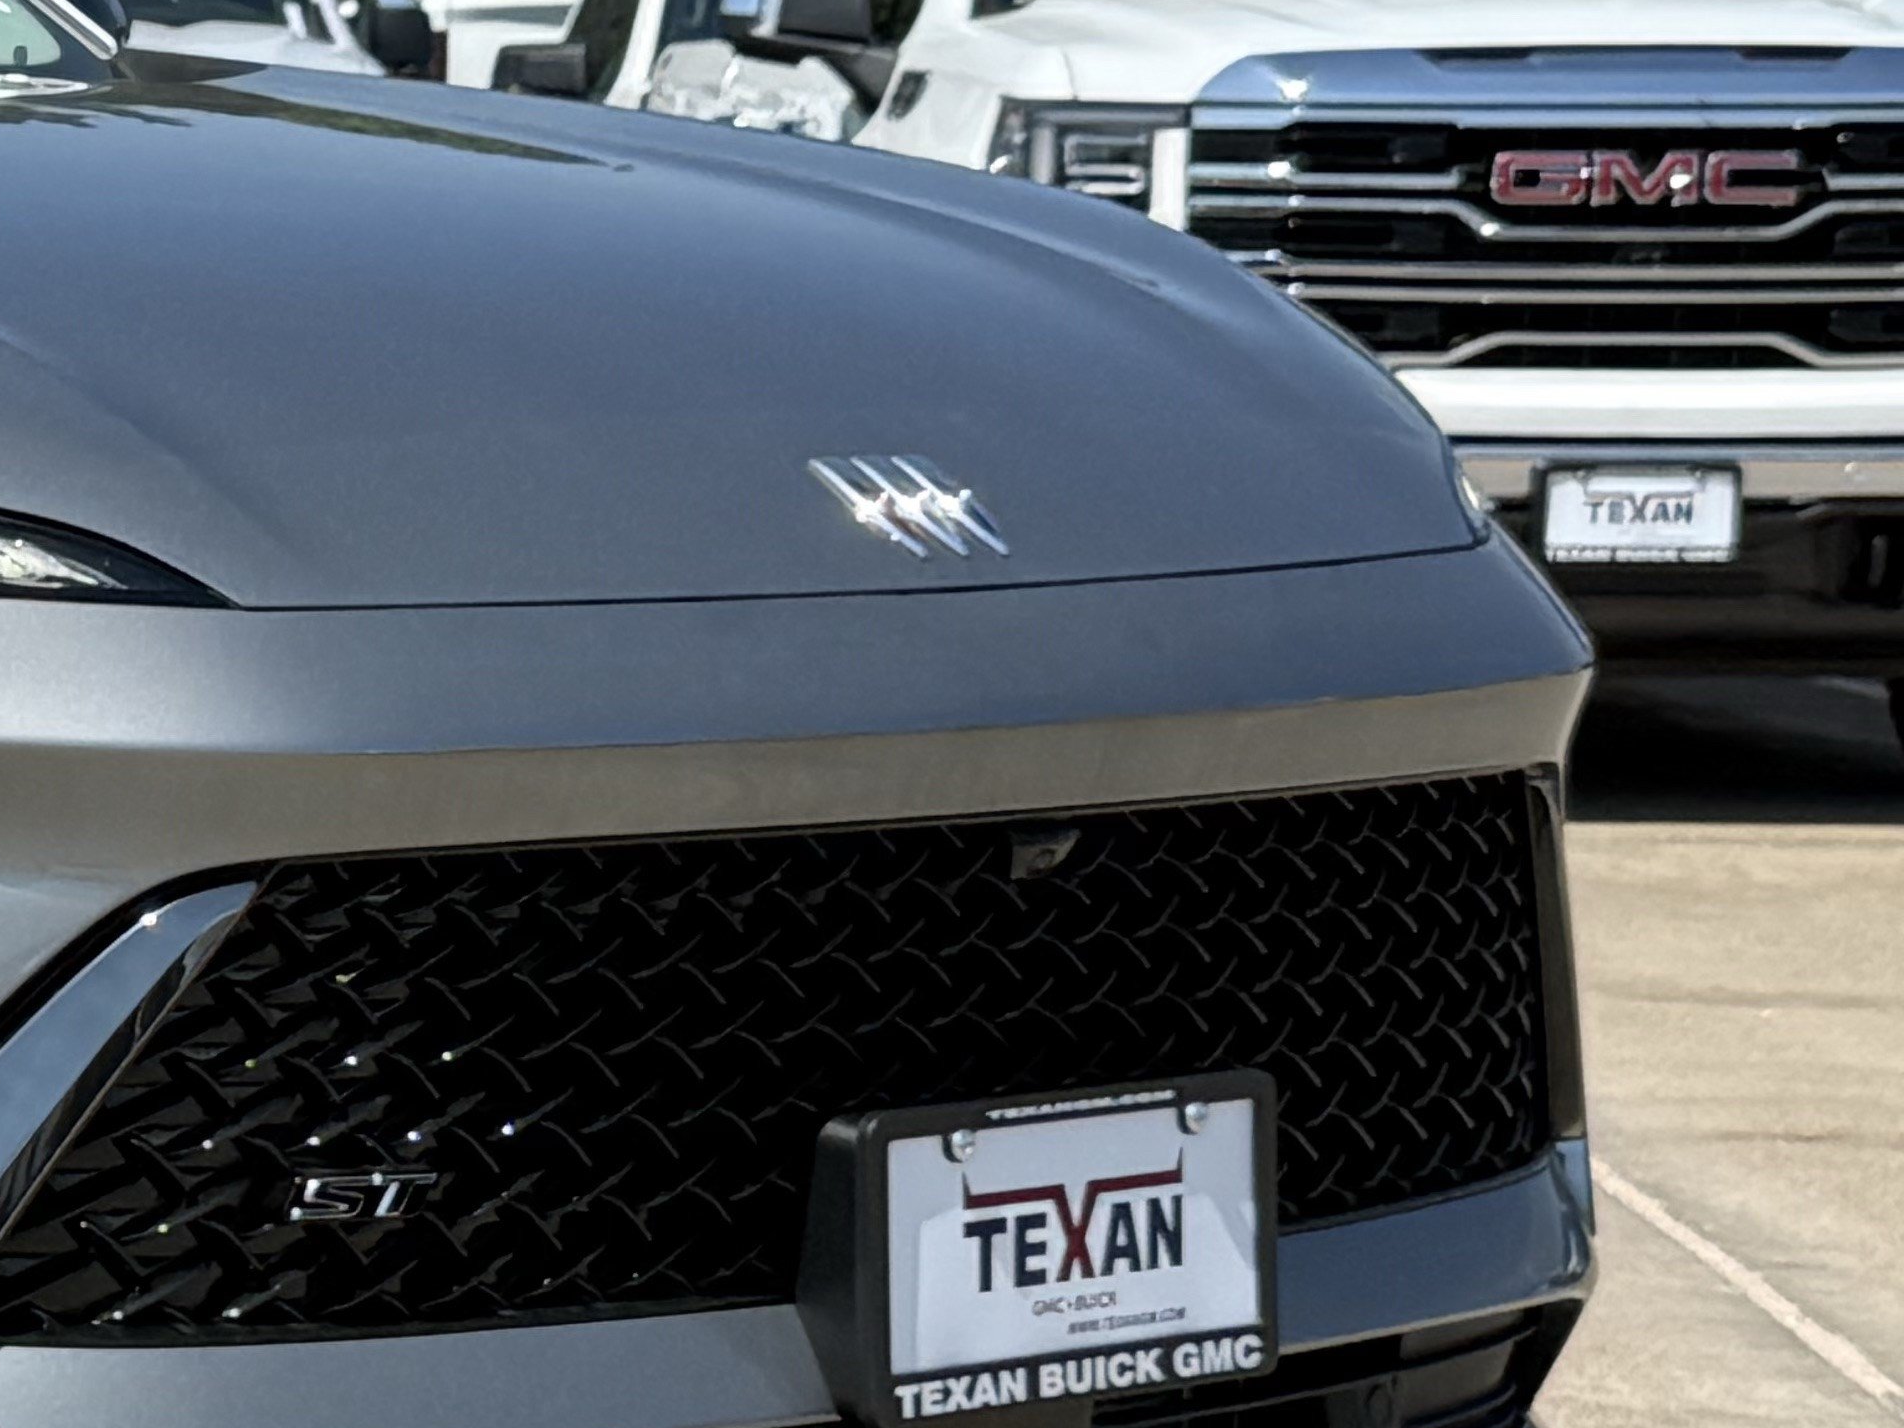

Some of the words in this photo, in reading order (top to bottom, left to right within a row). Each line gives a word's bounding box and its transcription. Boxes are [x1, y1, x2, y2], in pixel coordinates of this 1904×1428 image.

[1490, 149, 1798, 207] GMC
[1583, 492, 1695, 525] TEXAN
[288, 1172, 438, 1222] ST
[962, 1178, 1184, 1293] TEXAN
[893, 1367, 1028, 1420] TEXAN
[1038, 1347, 1167, 1398] BUICK
[1172, 1333, 1265, 1379] GMC
